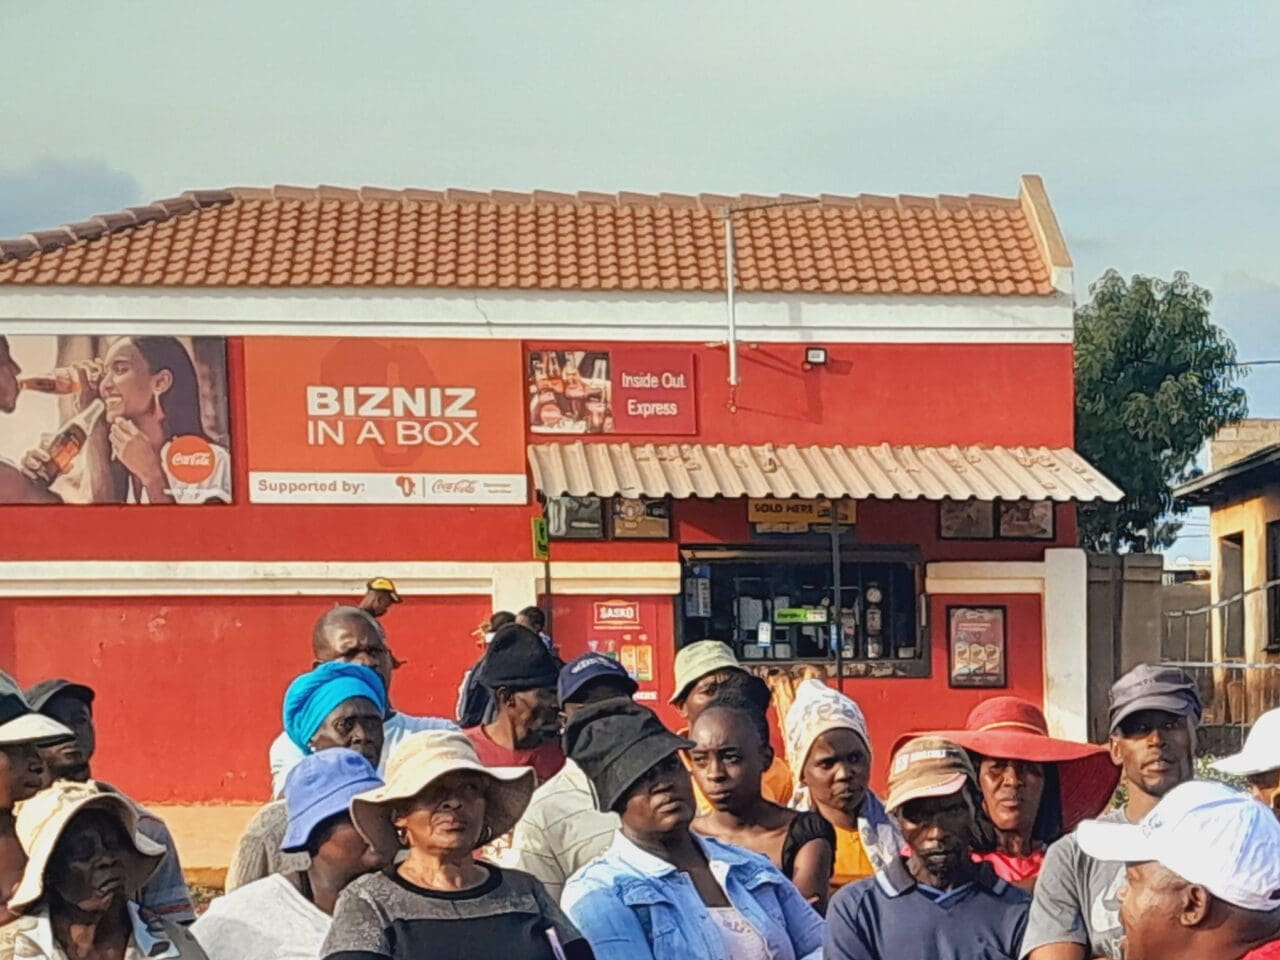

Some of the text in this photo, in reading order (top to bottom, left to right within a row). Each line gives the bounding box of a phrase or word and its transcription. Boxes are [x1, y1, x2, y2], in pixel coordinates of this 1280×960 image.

[621, 372, 659, 389] Inside
[306, 385, 478, 418] BIZNIZ
[627, 399, 678, 418] Express
[307, 420, 481, 447] IN A BOX
[257, 479, 366, 494] Supported by:
[754, 503, 813, 514] SOLD HERE
